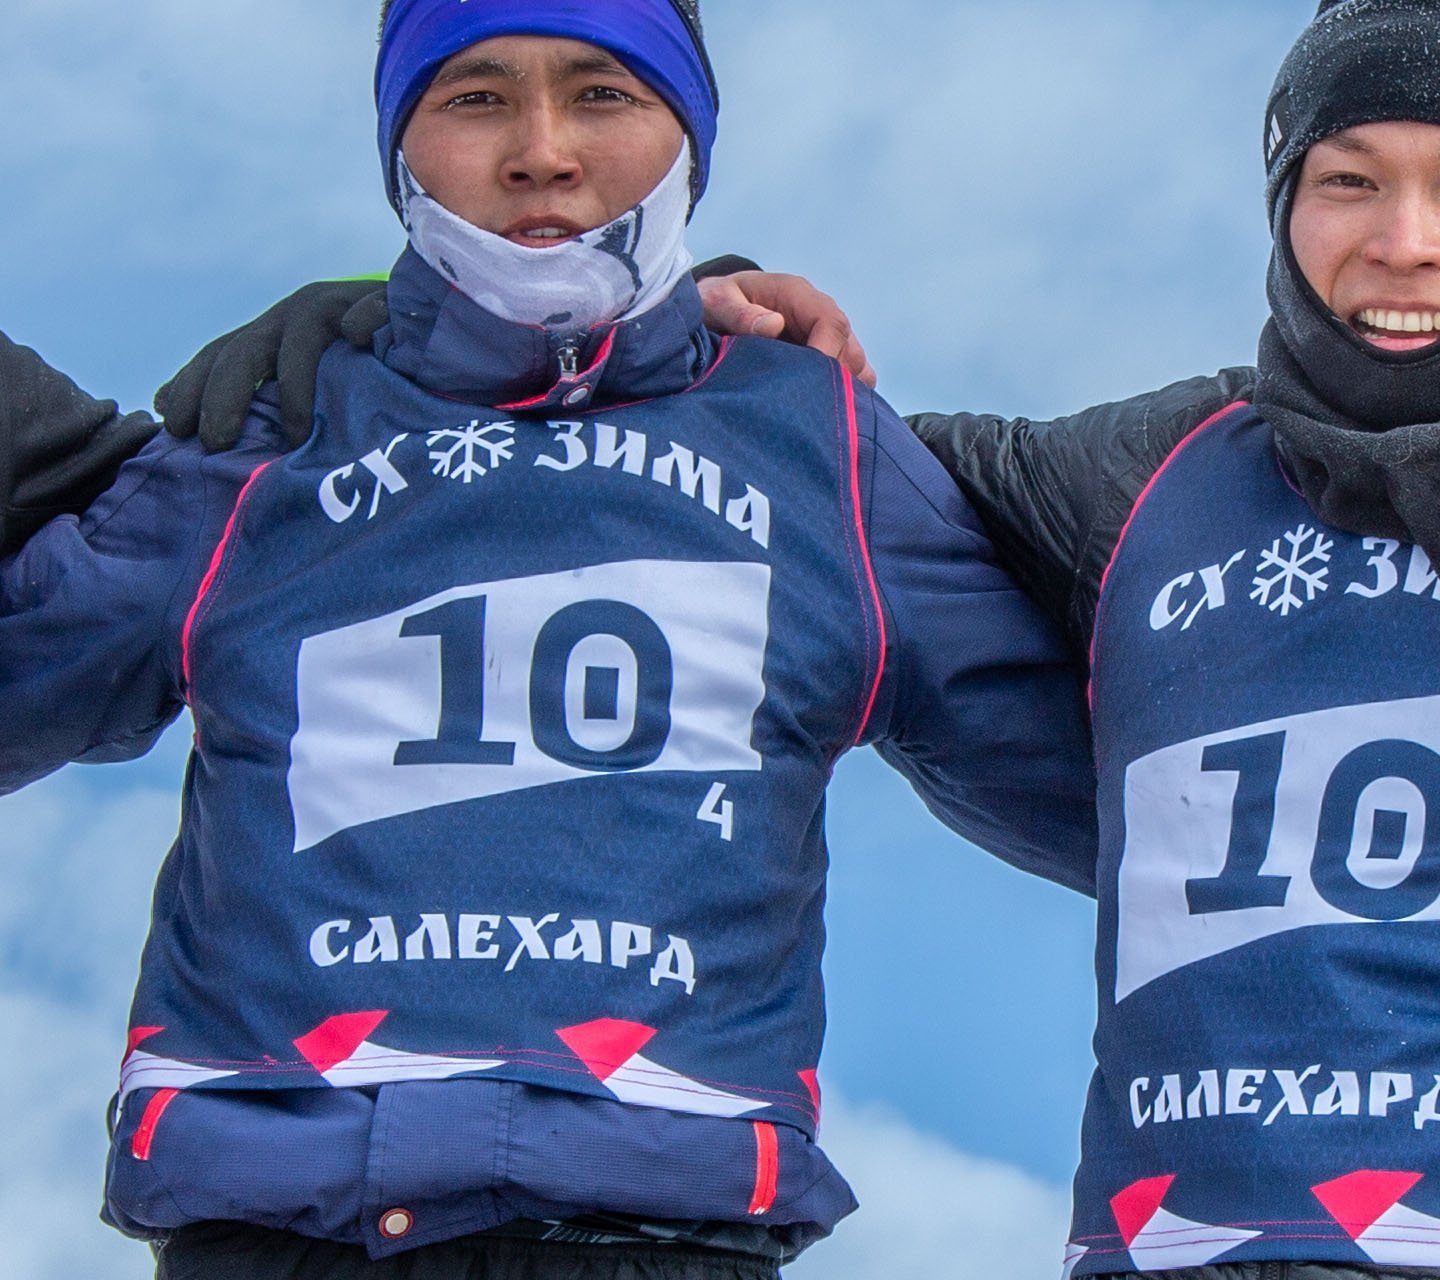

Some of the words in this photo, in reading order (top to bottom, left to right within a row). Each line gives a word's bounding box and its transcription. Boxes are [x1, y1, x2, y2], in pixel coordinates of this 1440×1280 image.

[318, 432, 410, 524] СХ
[533, 420, 771, 550] ЗИМА
[1148, 547, 1248, 632] СХ
[392, 594, 674, 772] 10
[695, 781, 734, 842] 4
[308, 912, 697, 996] САЛЕХАРД
